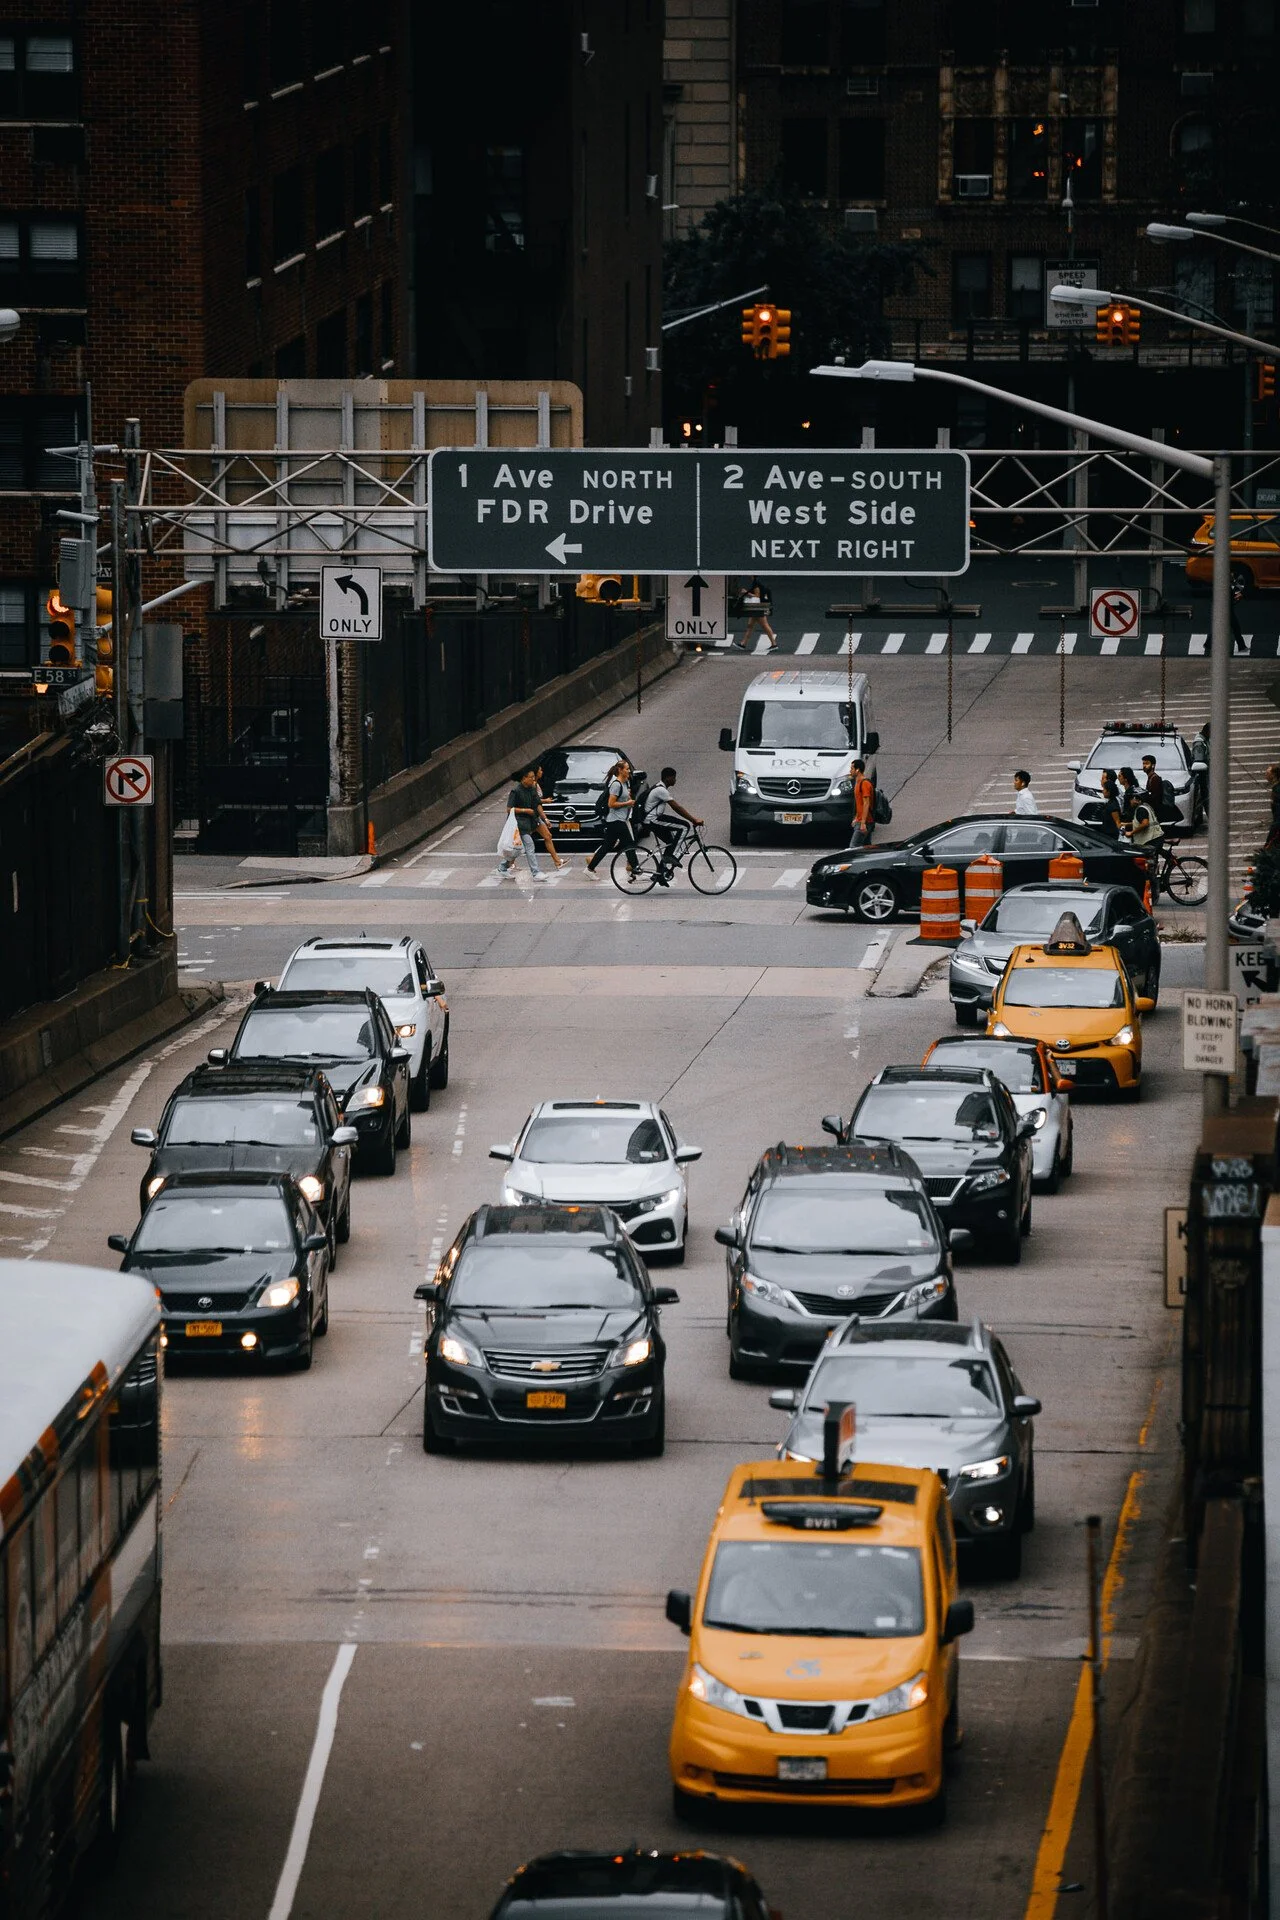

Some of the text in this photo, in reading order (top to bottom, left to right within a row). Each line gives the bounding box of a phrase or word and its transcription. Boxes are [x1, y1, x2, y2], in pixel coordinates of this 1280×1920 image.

[1058, 271, 1086, 280] SPEED
[459, 464, 671, 488] 1 Ave NORTH
[724, 465, 743, 488] 2
[478, 499, 652, 524] FDR Drive
[749, 500, 915, 524] West Side
[752, 540, 914, 558] NEXT RIGHT
[329, 618, 372, 633] ONLY
[674, 621, 718, 635] ONLY
[33, 670, 42, 682] E
[45, 670, 64, 683] 58
[771, 758, 823, 768] next
[1235, 951, 1266, 966] KEE
[1187, 997, 1202, 1009] NO
[1206, 998, 1233, 1011] HORN
[1187, 1014, 1233, 1029] BLOWING
[1195, 1033, 1224, 1042] EXCEPT
[1195, 1055, 1224, 1064] DANGER
